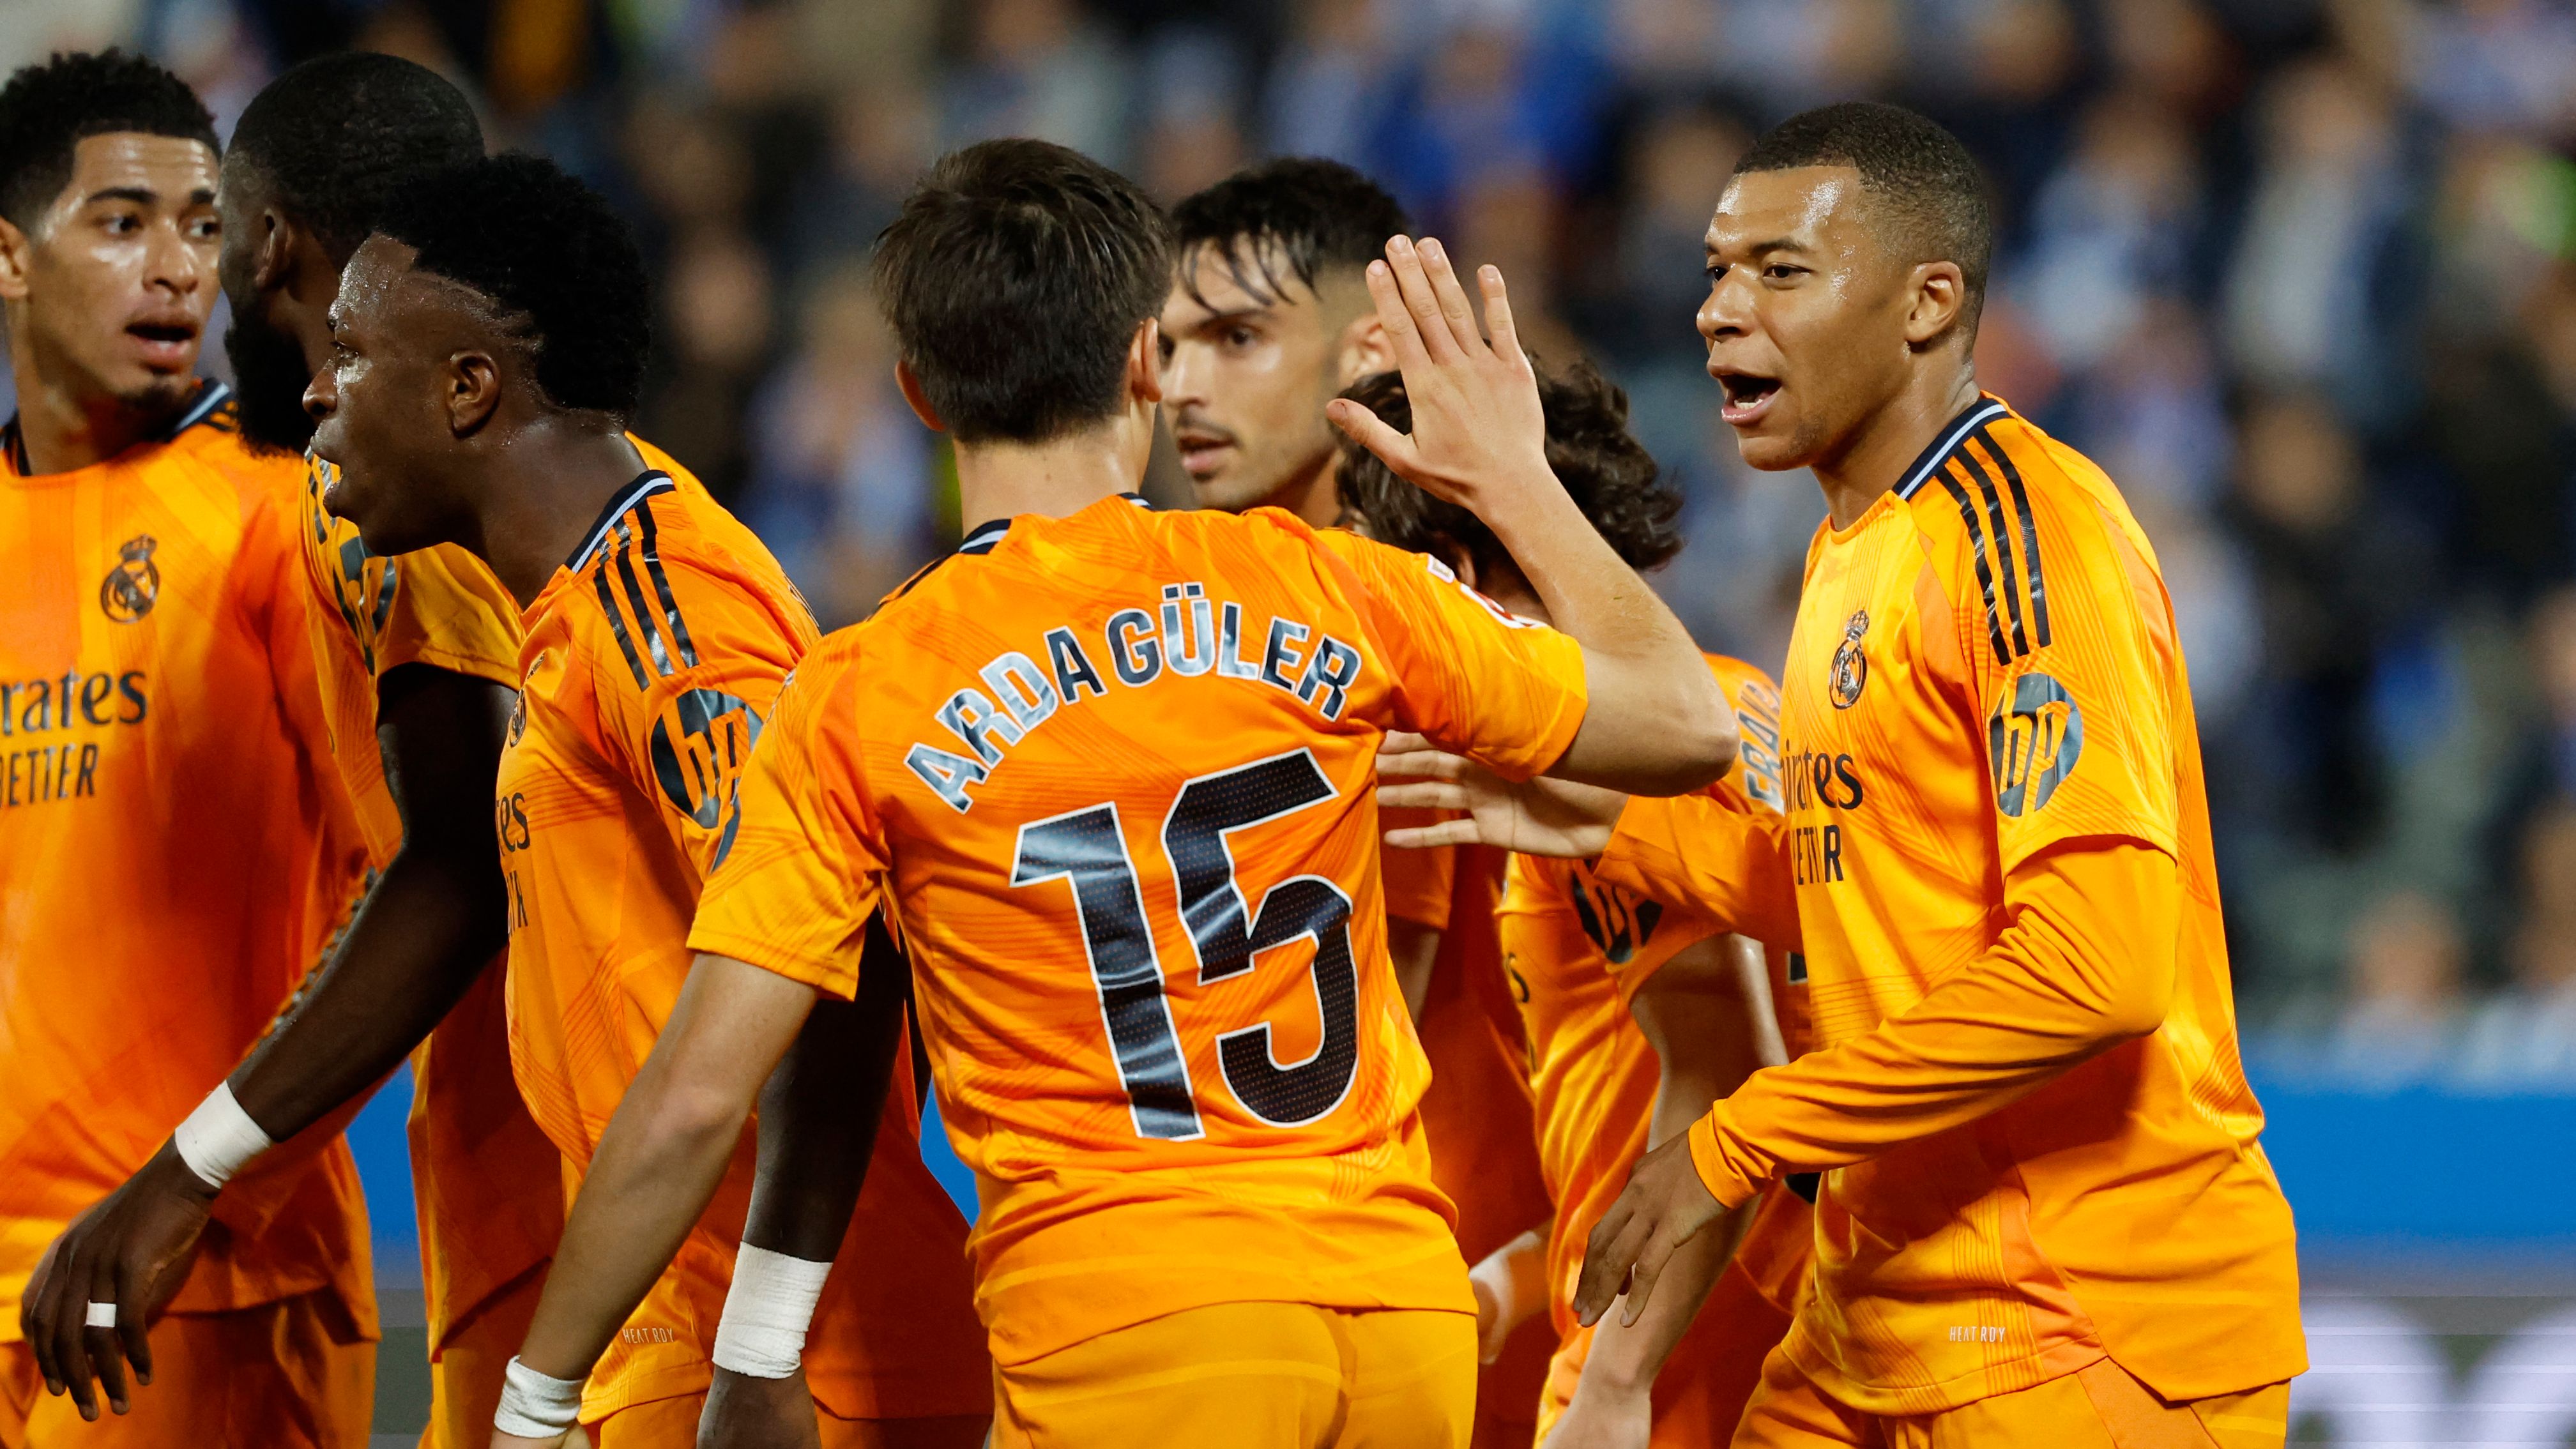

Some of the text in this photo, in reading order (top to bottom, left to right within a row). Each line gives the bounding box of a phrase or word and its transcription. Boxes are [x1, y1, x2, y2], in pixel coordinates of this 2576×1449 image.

[904, 582, 1362, 815] ARDA GÜLER
[0, 744, 99, 807] ETTER
[1009, 746, 1360, 1141] 15
[622, 1328, 650, 1344] HEAT
[1949, 1326, 1978, 1342] HEAT
